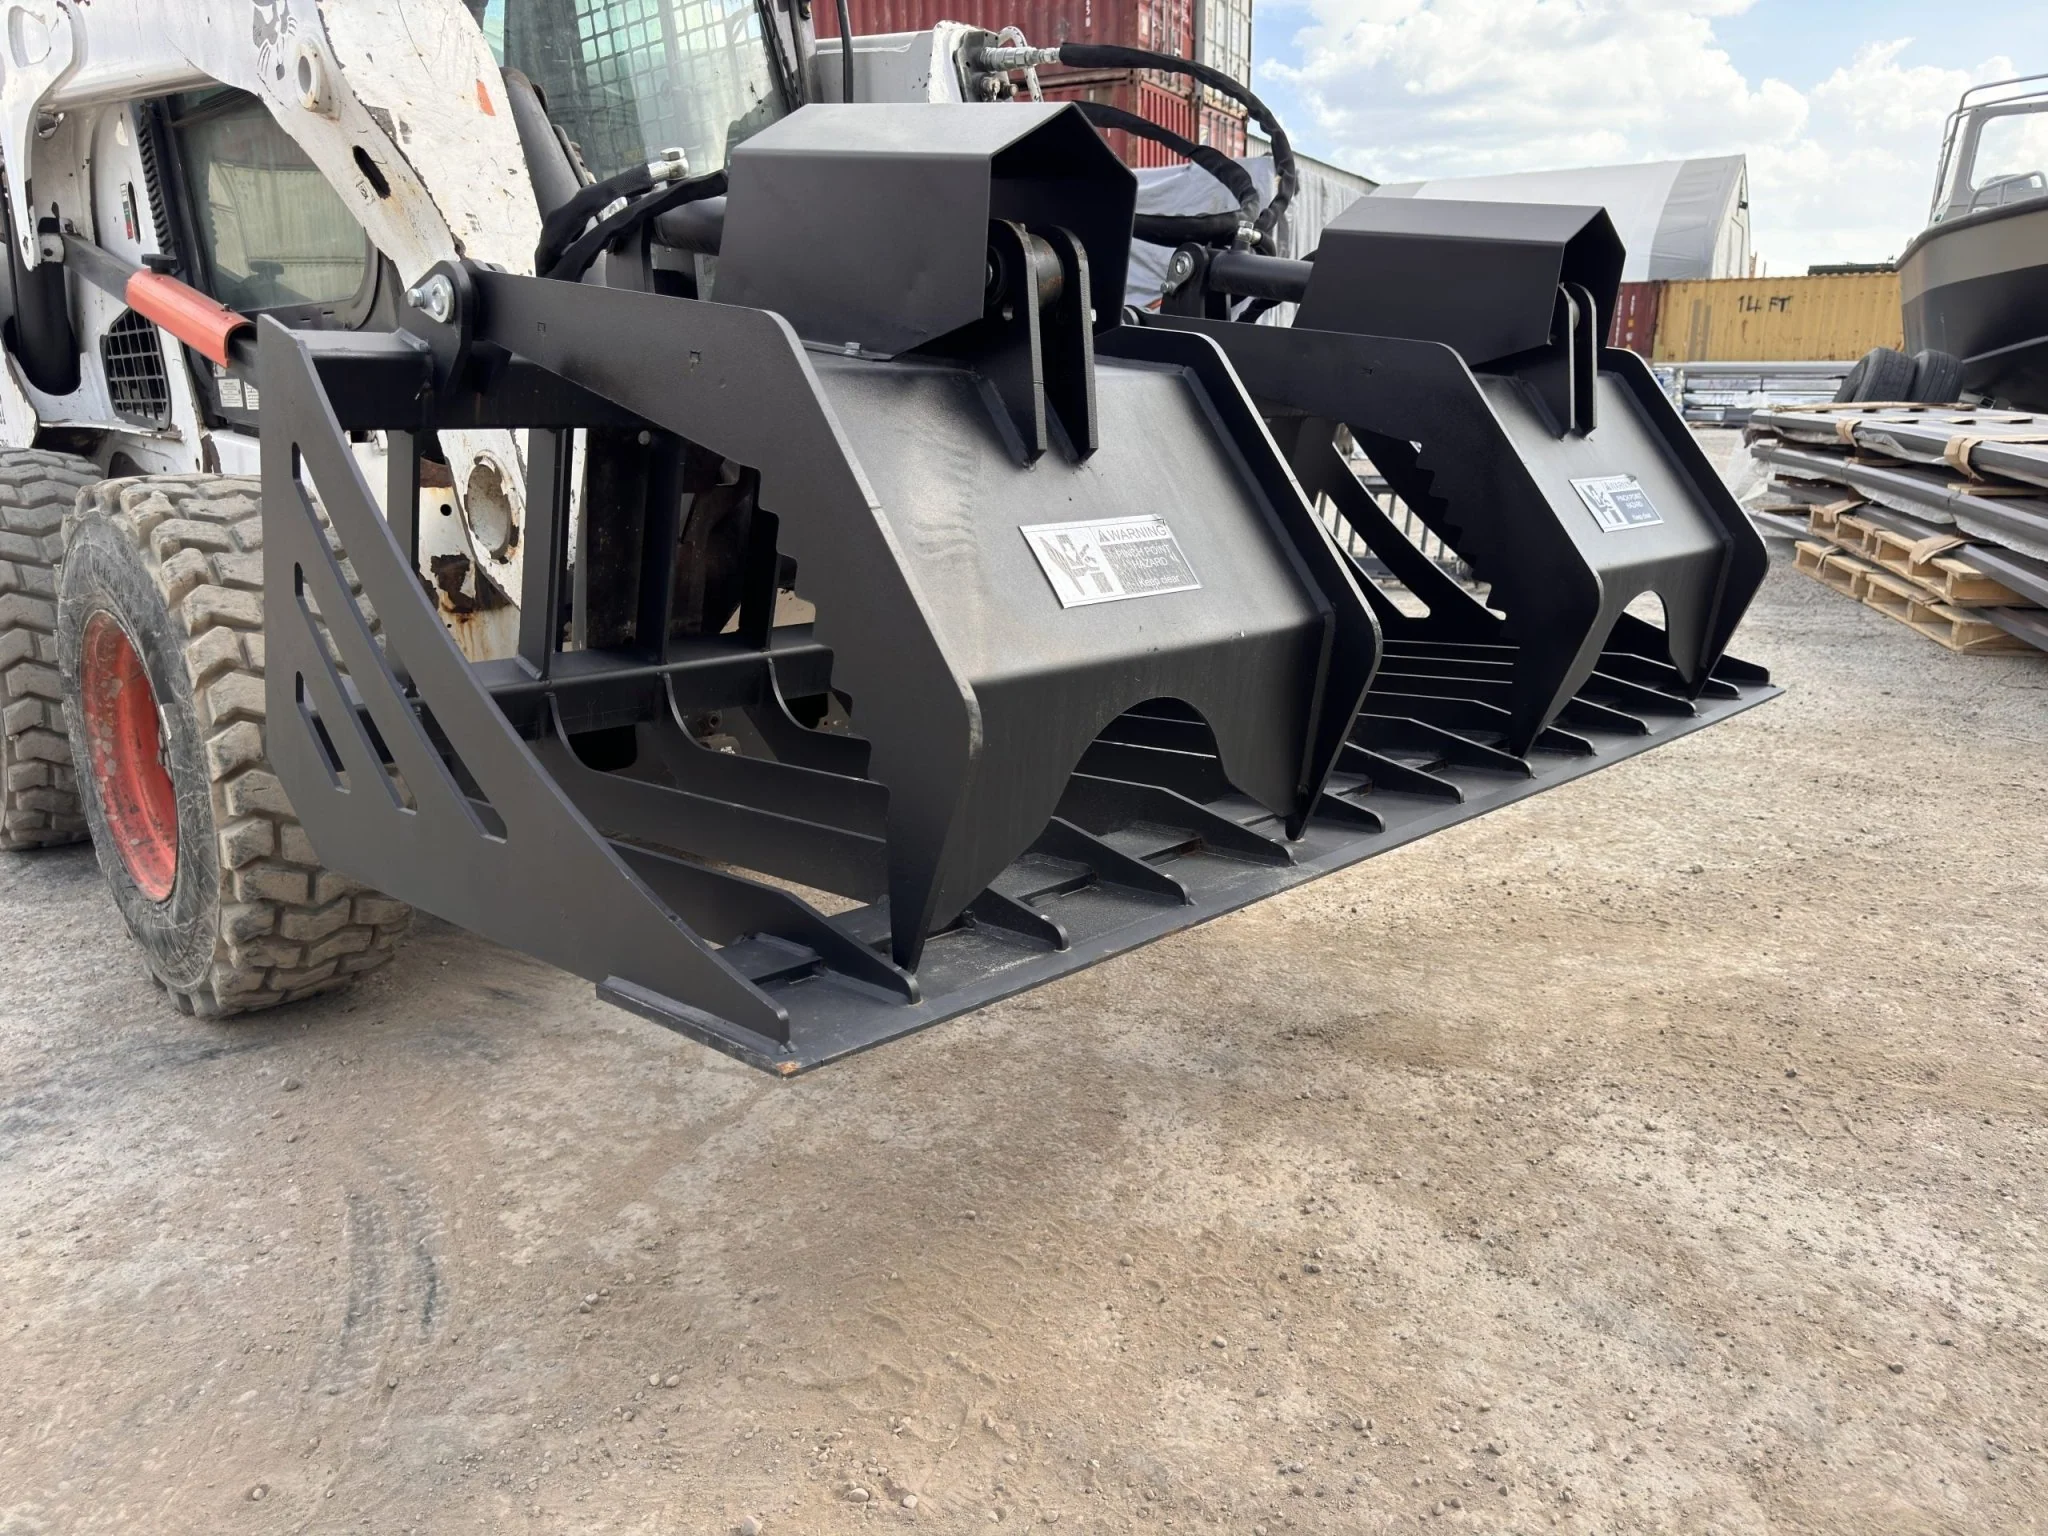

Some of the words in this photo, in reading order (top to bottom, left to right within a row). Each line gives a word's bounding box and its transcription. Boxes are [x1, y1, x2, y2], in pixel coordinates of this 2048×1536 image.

[1739, 295, 1762, 313] 14
[1768, 295, 1793, 312] FT
[1107, 525, 1167, 541] WARNING
[1116, 547, 1144, 559] PINCH
[1144, 544, 1170, 556] POINT
[1131, 556, 1168, 569] HAZARD
[1138, 578, 1160, 589] Keep
[1160, 575, 1180, 585] clear
